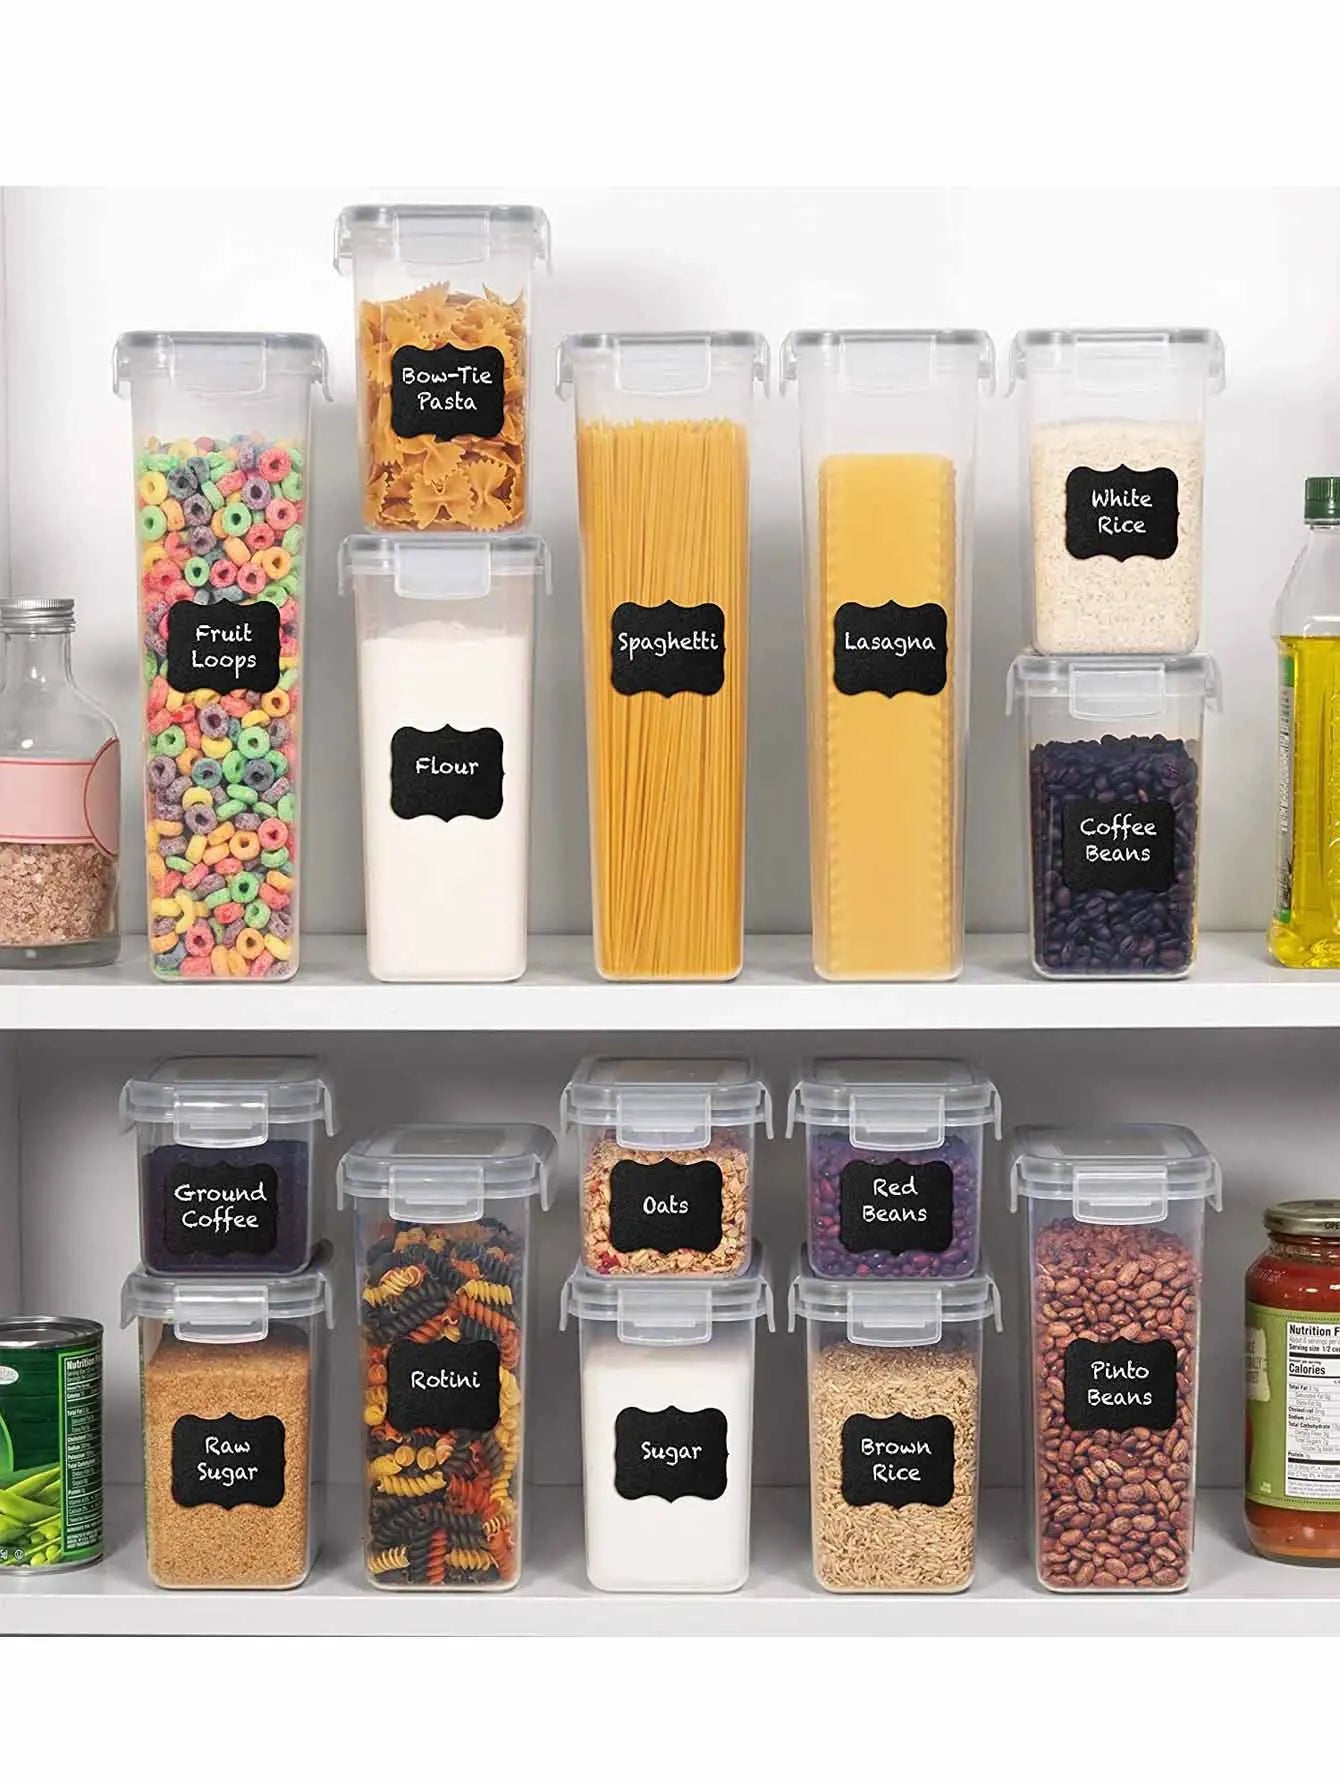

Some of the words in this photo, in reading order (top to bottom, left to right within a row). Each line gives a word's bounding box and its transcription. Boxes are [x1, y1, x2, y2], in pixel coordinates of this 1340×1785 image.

[402, 365, 493, 385] Bow-Tie
[417, 390, 478, 411] Pasta
[1091, 488, 1153, 508] White
[1098, 515, 1147, 536] Rice
[195, 622, 253, 643] Fruit
[617, 630, 719, 661] Spaghetti
[844, 631, 936, 657] Lasagna
[191, 649, 257, 680] Loops
[415, 755, 480, 776] Flour
[1080, 812, 1157, 842] Coffee
[1085, 844, 1151, 863] Beans
[173, 1181, 268, 1203] Ground
[873, 1175, 919, 1198] Red
[642, 1194, 689, 1215] Oats
[862, 1204, 927, 1223] Beans
[181, 1205, 259, 1234] Coffee
[1289, 1324, 1331, 1336] Nutrition
[1289, 1344, 1308, 1352] Serving
[411, 1368, 481, 1390] Rotini
[1090, 1359, 1150, 1380] Pinto
[1289, 1363, 1326, 1375] Calories
[1087, 1388, 1153, 1407] Beans
[205, 1436, 251, 1456] Raw
[640, 1440, 703, 1467] Sugar
[861, 1437, 932, 1456] Brown
[196, 1461, 259, 1488] Sugar
[872, 1463, 922, 1483] Rice
